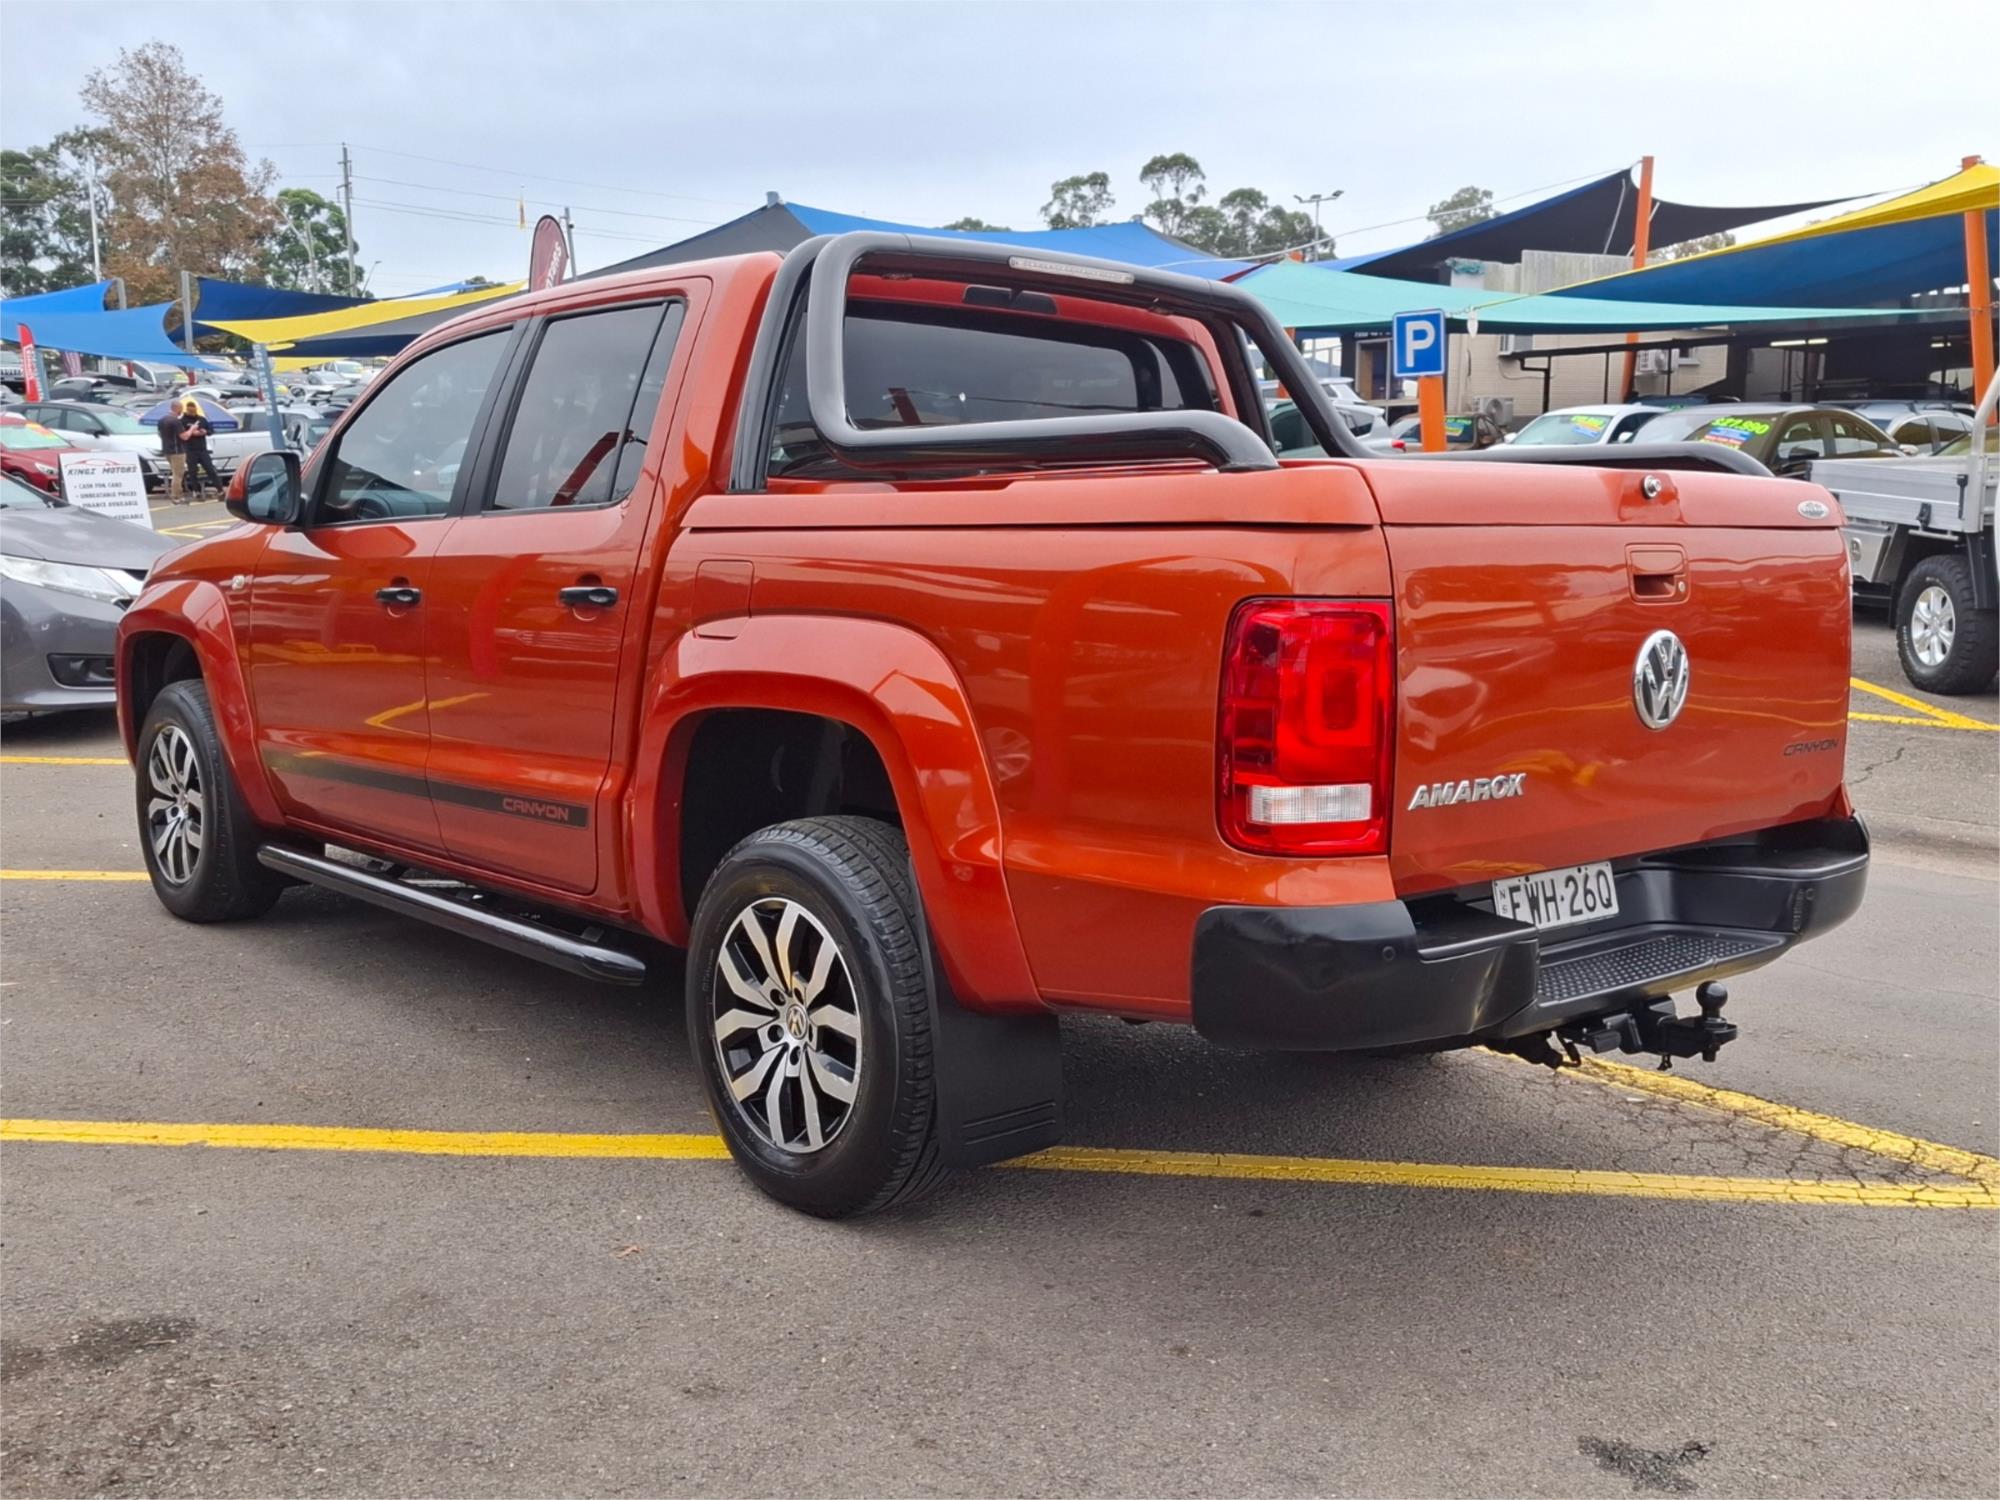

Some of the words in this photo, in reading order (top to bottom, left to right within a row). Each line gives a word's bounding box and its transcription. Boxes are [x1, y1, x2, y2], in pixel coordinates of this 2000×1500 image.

[1405, 320, 1436, 368] P
[1783, 739, 1839, 756] CANYON
[1407, 773, 1526, 811] AMAROK
[502, 797, 569, 821] CANYON
